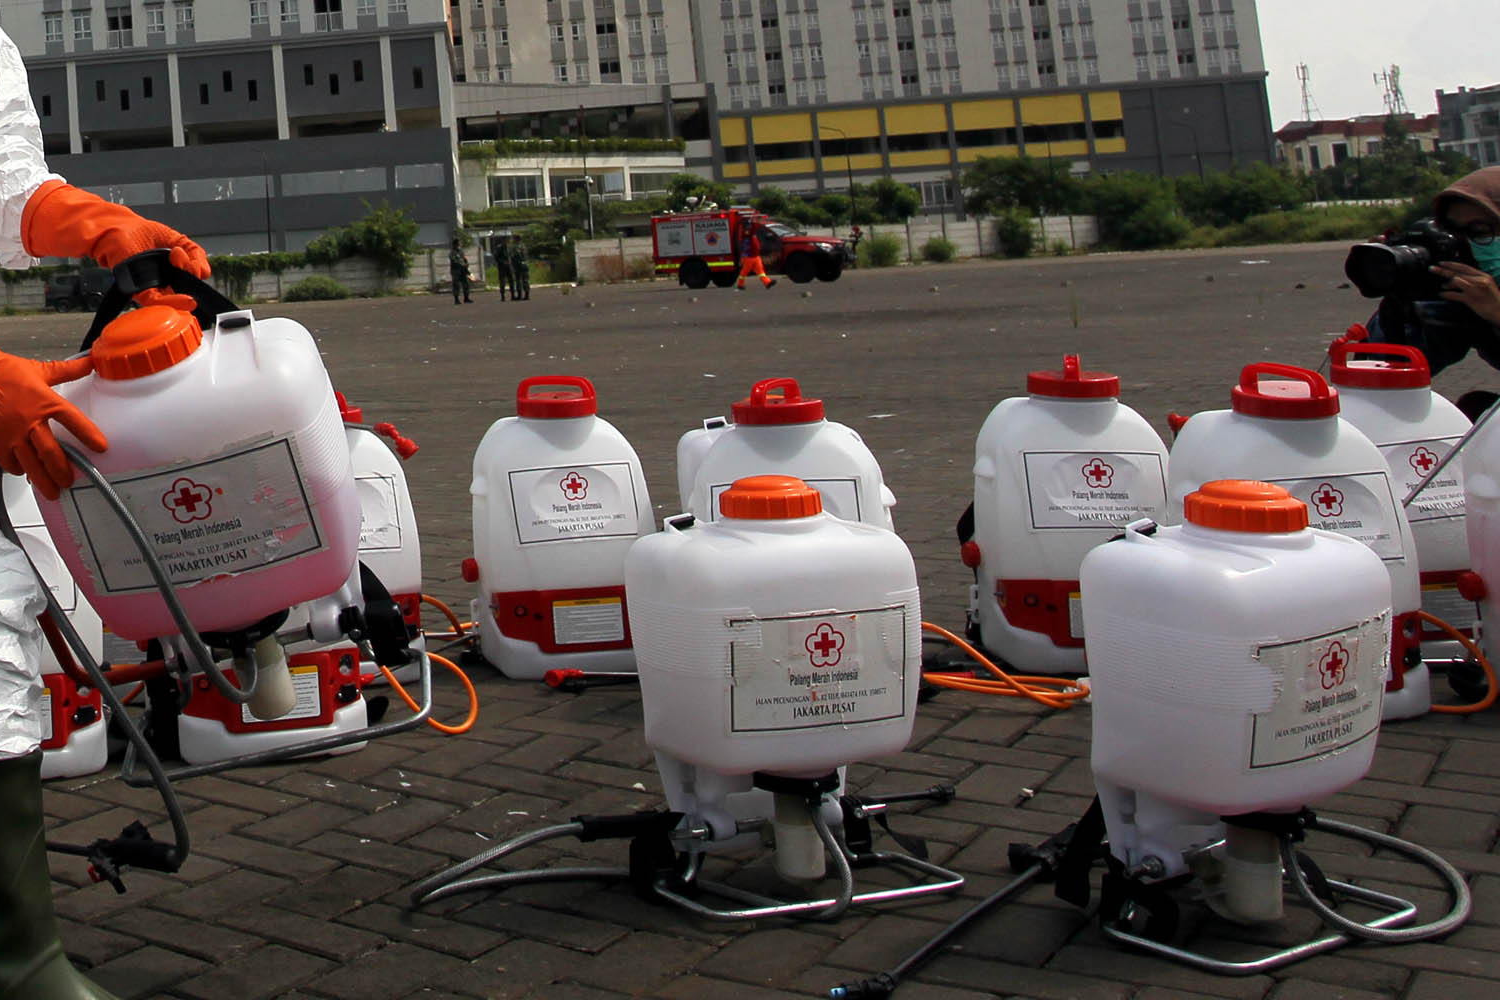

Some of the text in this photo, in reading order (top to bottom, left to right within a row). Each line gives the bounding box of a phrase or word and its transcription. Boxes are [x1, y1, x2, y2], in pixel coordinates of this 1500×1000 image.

[1072, 490, 1090, 501] Palang
[1104, 490, 1129, 499] Indonesia
[1079, 513, 1109, 522] JAKARTA
[154, 516, 242, 545] Palang Merah Indonesia
[558, 522, 604, 533] JAKARTA PUSAT
[168, 549, 248, 576] JAKARTA PUSAT
[790, 670, 858, 687] Palang Merah Indonesia
[793, 702, 856, 720] JAKARTA PUSAT
[1304, 699, 1321, 713] Palang
[1305, 722, 1353, 749] JAKARTA PUSAT
